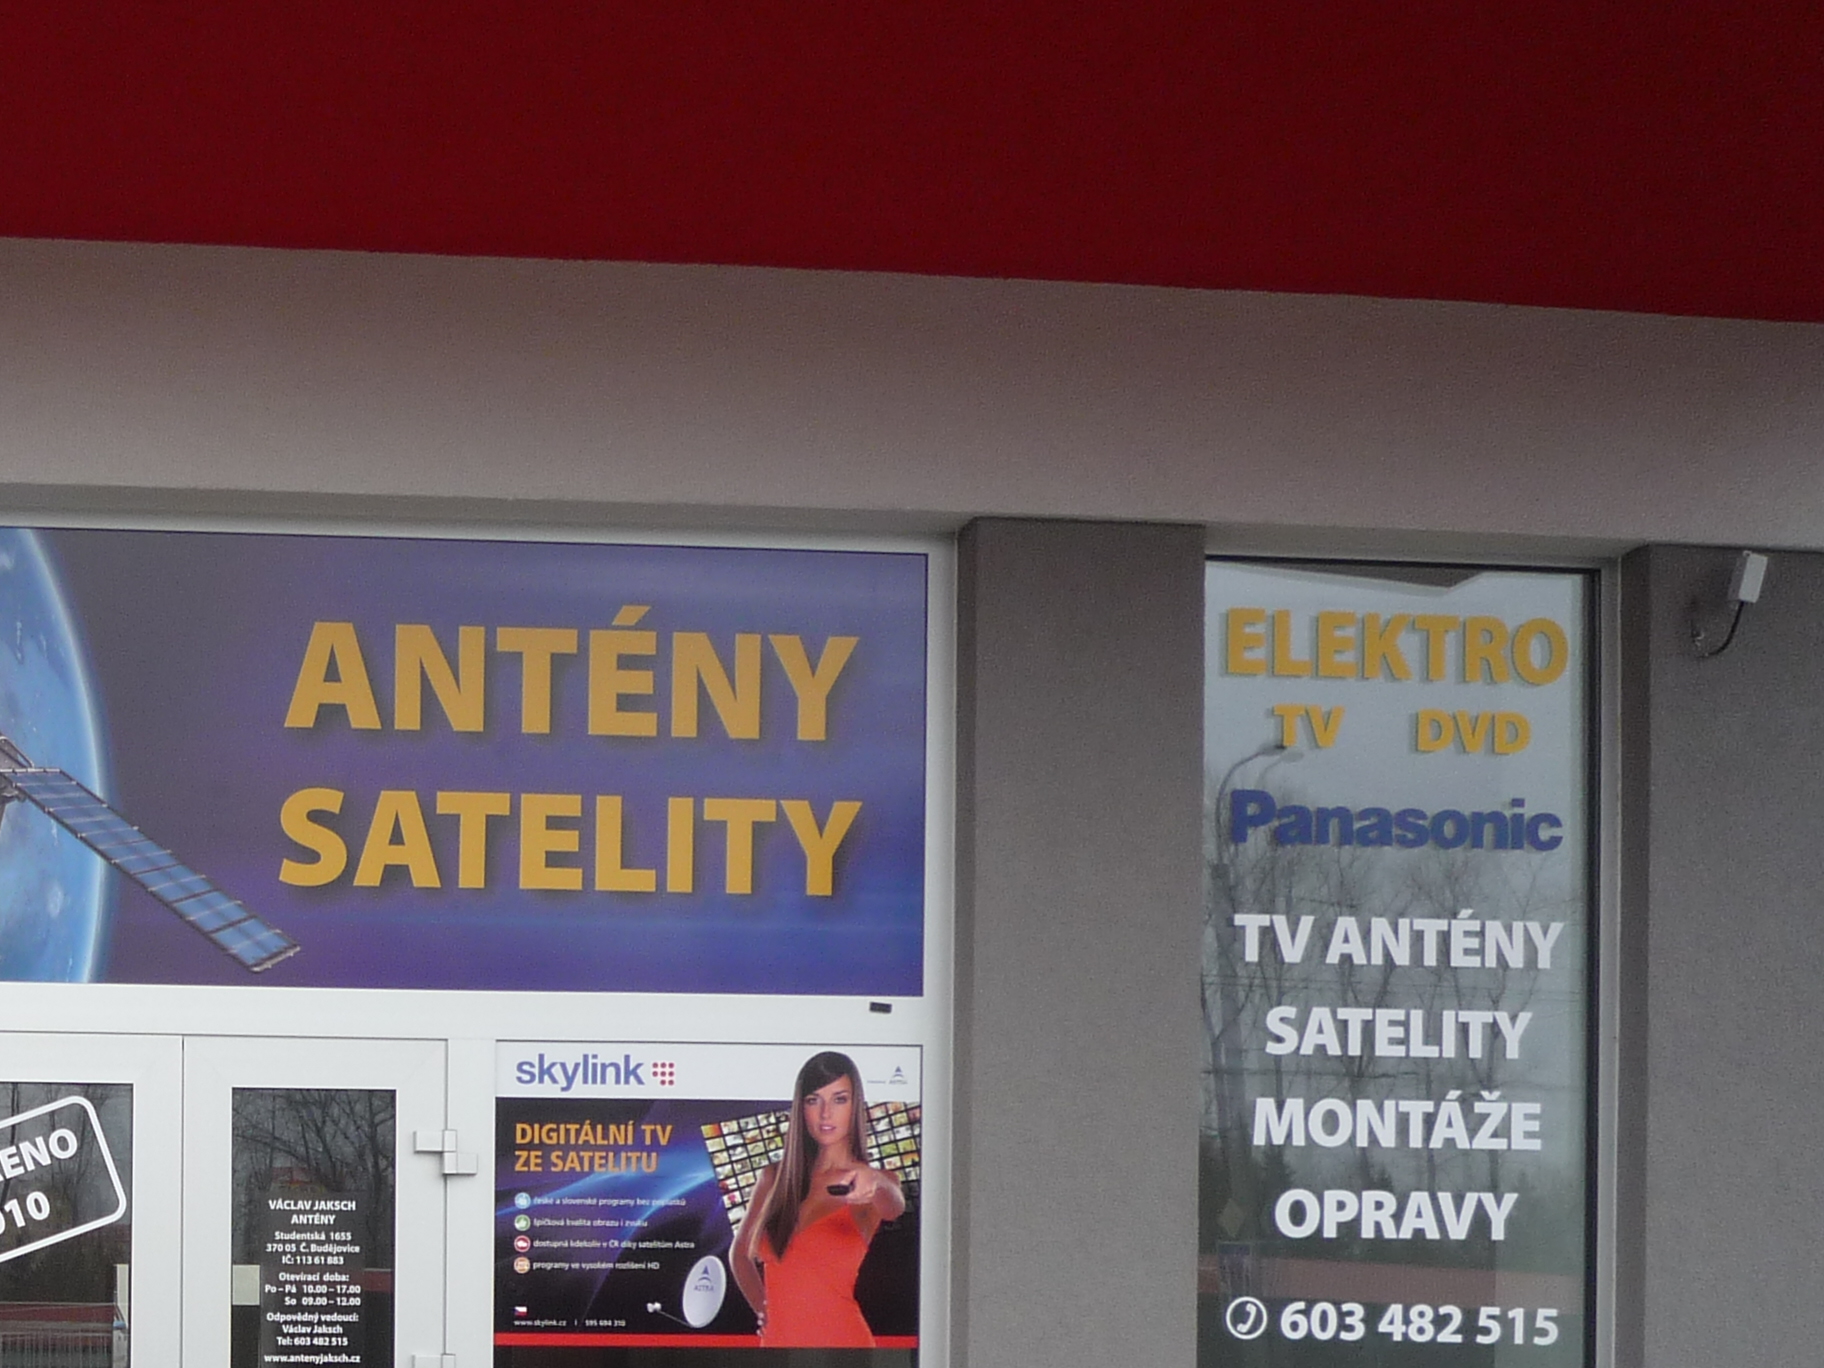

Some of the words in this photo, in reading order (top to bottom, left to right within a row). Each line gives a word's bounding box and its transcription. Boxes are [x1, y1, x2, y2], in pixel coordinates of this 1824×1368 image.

[1225, 607, 1568, 686] ELEKTRO
[283, 606, 859, 741] ANTÉNY
[1273, 704, 1344, 748] TV
[1417, 710, 1530, 754] DVD
[279, 787, 863, 896] SATELITY
[1230, 789, 1563, 852] Panasonic
[1234, 913, 1314, 963] TV
[1325, 909, 1563, 968] ANTÉNY
[1265, 1006, 1532, 1059] SATELITY
[515, 1053, 645, 1092] skylink
[515, 1119, 634, 1145] DIGITÁLNÍ
[641, 1124, 672, 1146] TV
[1253, 1090, 1541, 1150] MONTÁŽE
[514, 1150, 543, 1172] ZE
[550, 1150, 658, 1173] SATELITU
[268, 1198, 311, 1210] VÁCLAV
[313, 1200, 356, 1211] JAKSCH
[291, 1212, 336, 1225] ANTÉNY
[1275, 1189, 1518, 1240] OPRAVY
[266, 1243, 284, 1252] 370
[310, 1242, 361, 1255] Budějovice
[274, 1230, 326, 1240] Studentská
[330, 1231, 352, 1241] 1655
[1280, 1302, 1365, 1342] 603
[1378, 1304, 1463, 1343] 482
[1475, 1307, 1559, 1345] 515
[264, 1353, 361, 1365] www.antenyjaksch.cz
